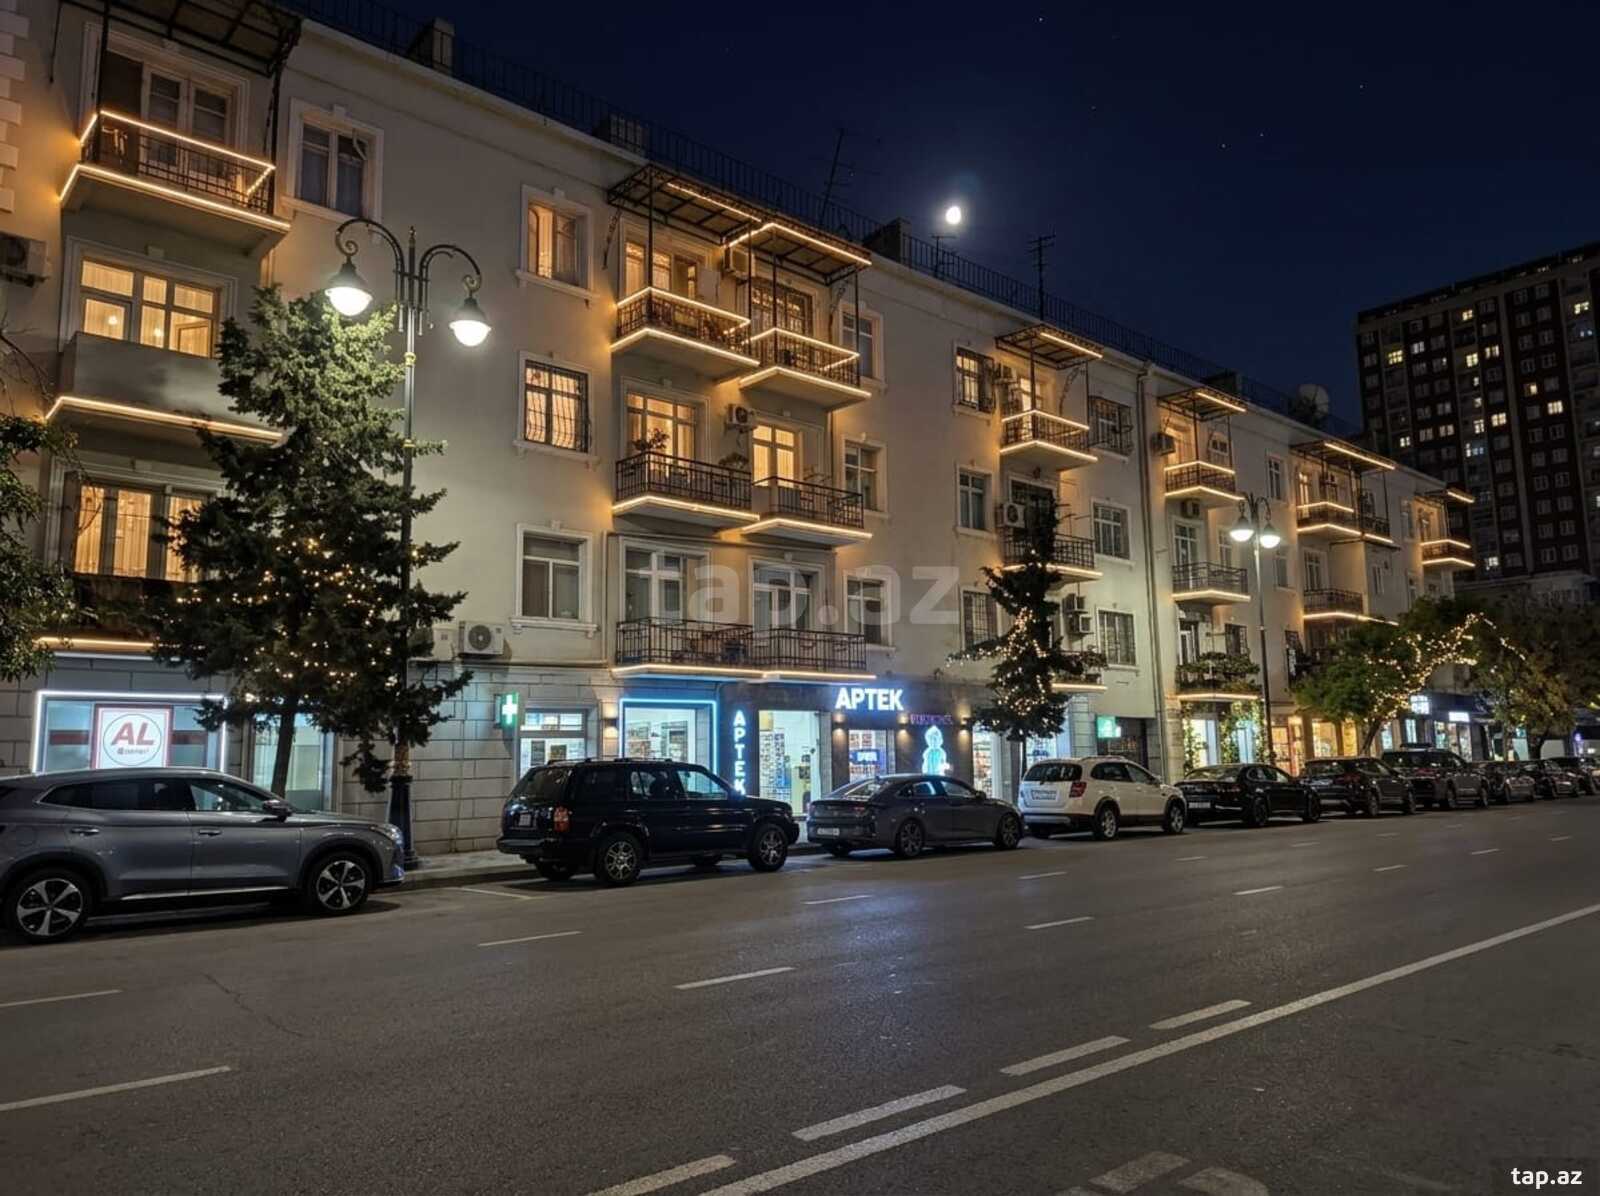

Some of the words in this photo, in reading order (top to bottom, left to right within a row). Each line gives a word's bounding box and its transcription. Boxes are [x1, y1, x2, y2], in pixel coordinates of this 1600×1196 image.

[834, 687, 904, 711] APTEK
[111, 721, 155, 746] AL
[733, 709, 746, 796] APTEK
